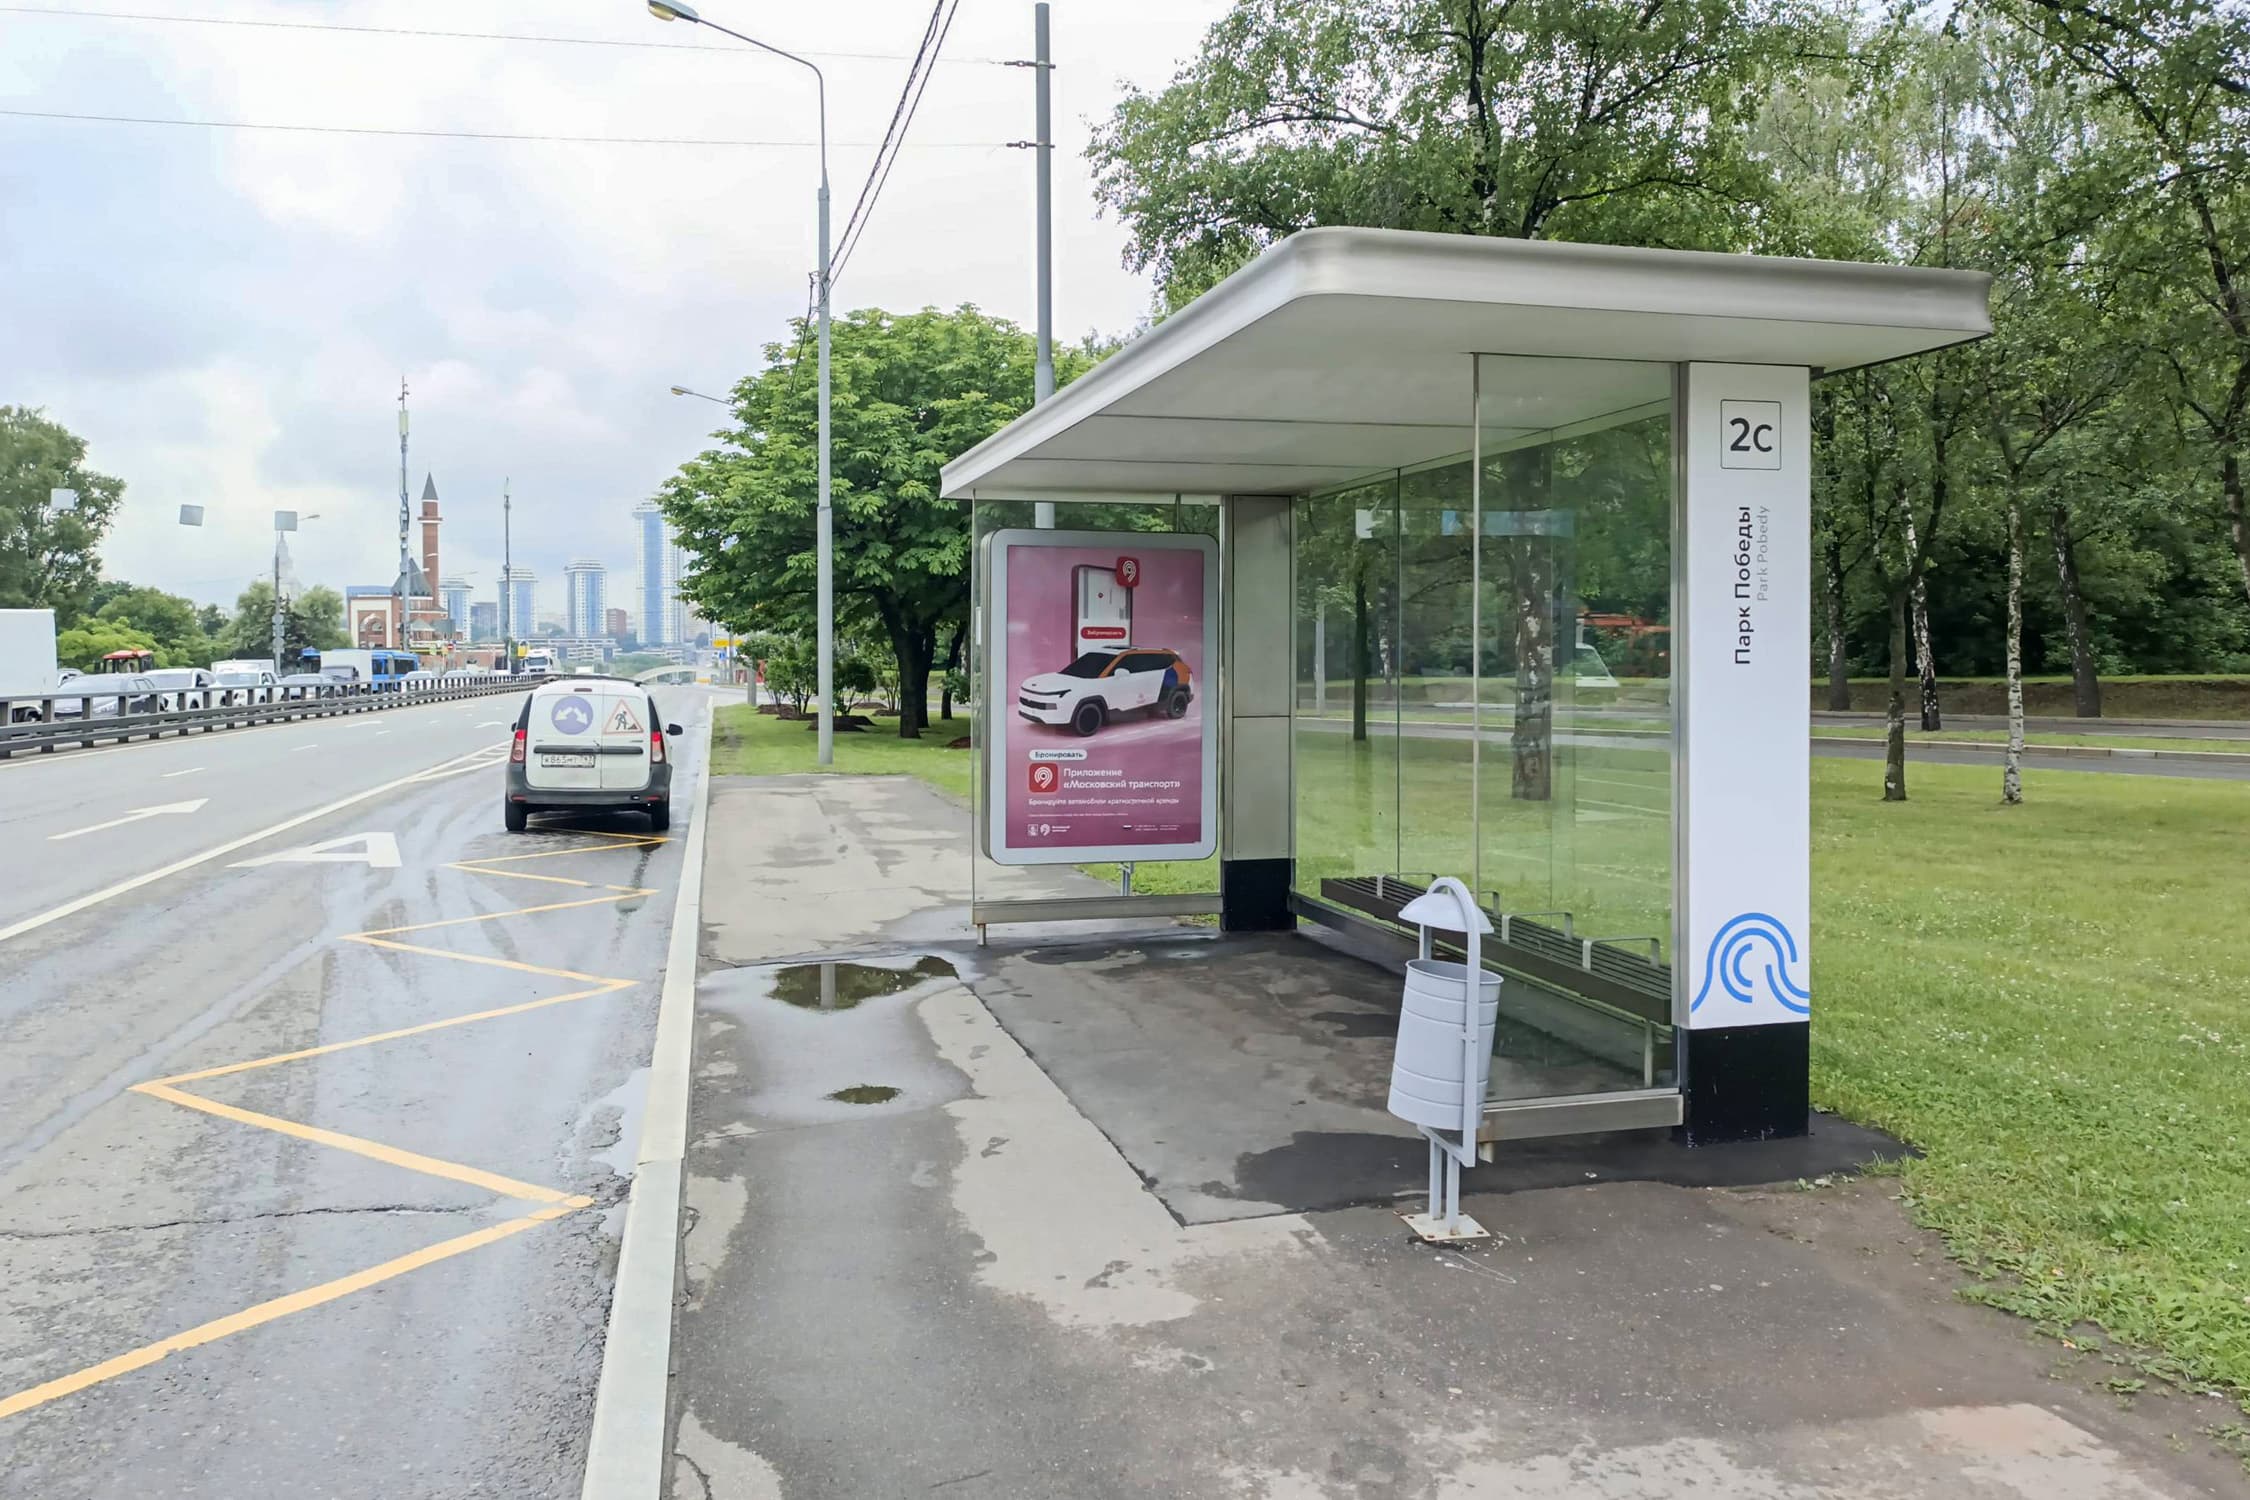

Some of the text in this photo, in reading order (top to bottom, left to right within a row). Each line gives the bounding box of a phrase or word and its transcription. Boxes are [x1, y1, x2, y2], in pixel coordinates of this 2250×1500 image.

[1757, 505, 1770, 601] Park Pobedy
[1734, 506, 1754, 665] Парк Победы
[1063, 767, 1122, 778] Приложение
[1063, 779, 1181, 790] «Московский транспорт»
